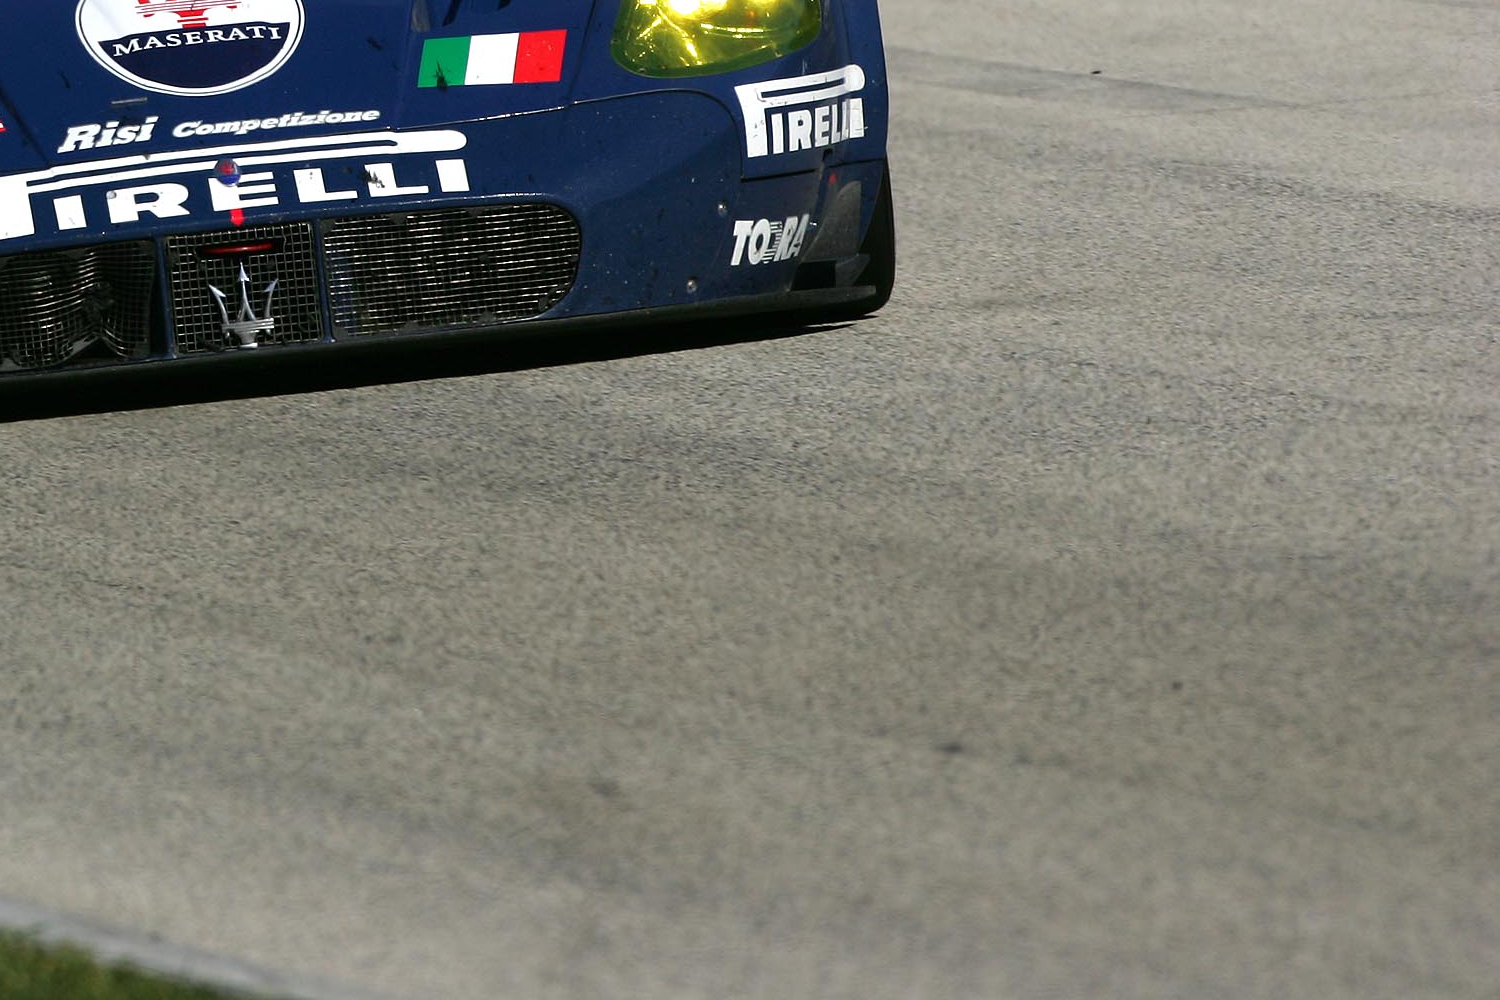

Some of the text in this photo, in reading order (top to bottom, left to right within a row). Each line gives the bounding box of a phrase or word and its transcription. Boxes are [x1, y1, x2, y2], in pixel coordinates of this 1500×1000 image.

[113, 25, 282, 57] MASERATI
[57, 109, 381, 154] Risi Competizione
[734, 64, 866, 158] PIRELLI
